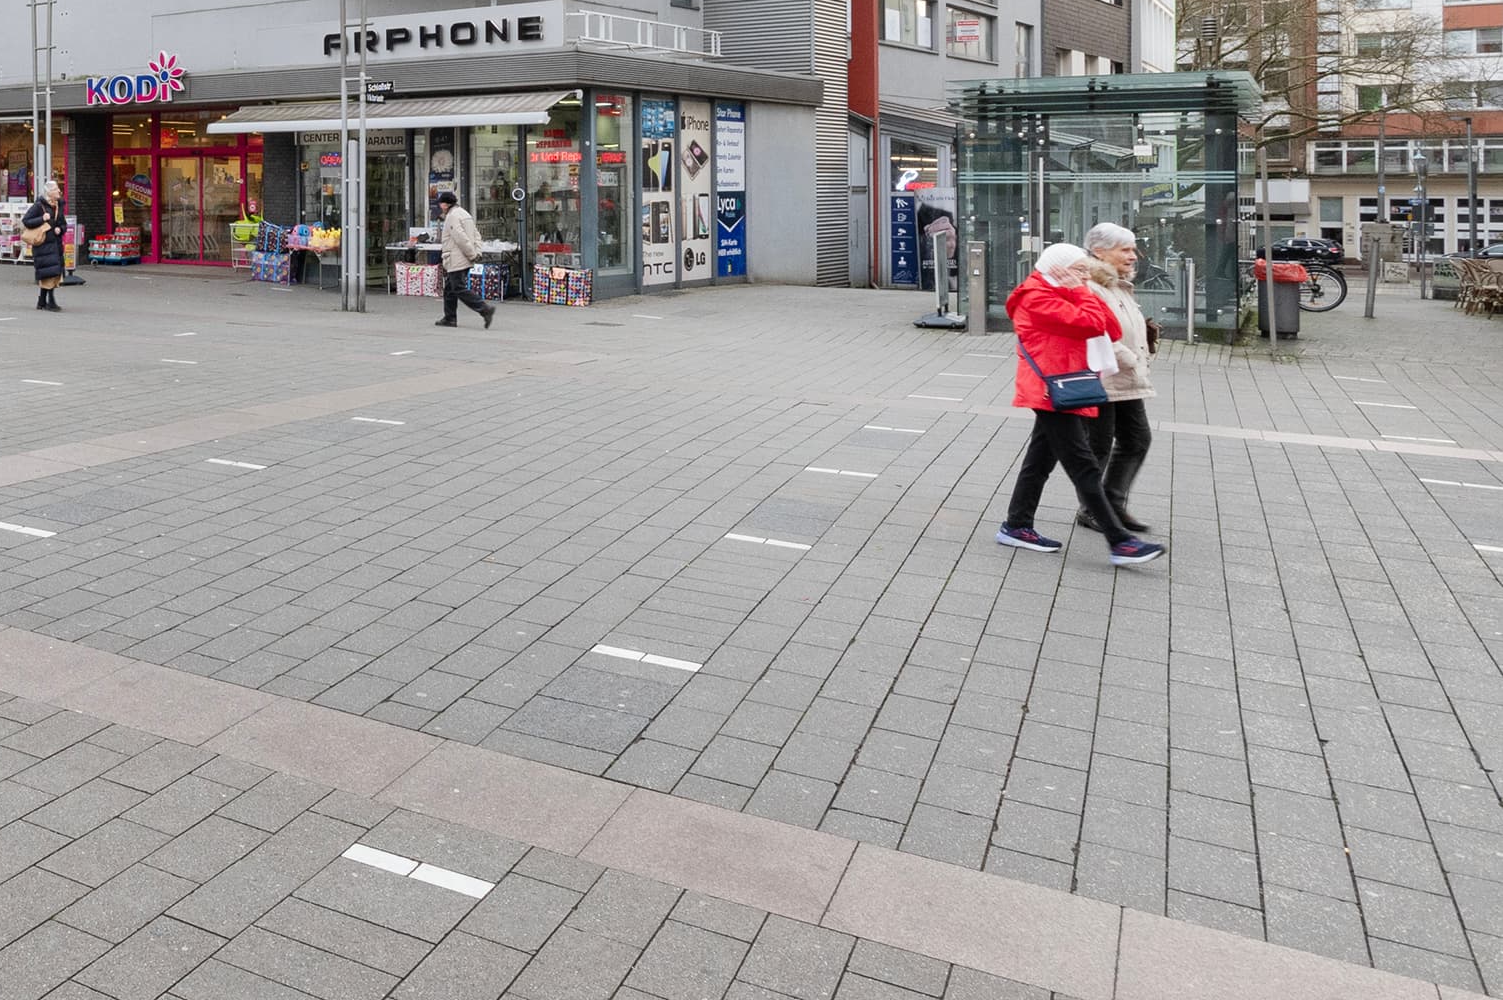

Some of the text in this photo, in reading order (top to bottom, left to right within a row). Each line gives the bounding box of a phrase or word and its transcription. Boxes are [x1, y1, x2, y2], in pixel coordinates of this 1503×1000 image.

[687, 115, 709, 131] iPhone
[303, 132, 339, 143] CENTER
[125, 181, 152, 196] DISCOUN
[717, 196, 736, 214] Lyca
[696, 251, 706, 266] LG
